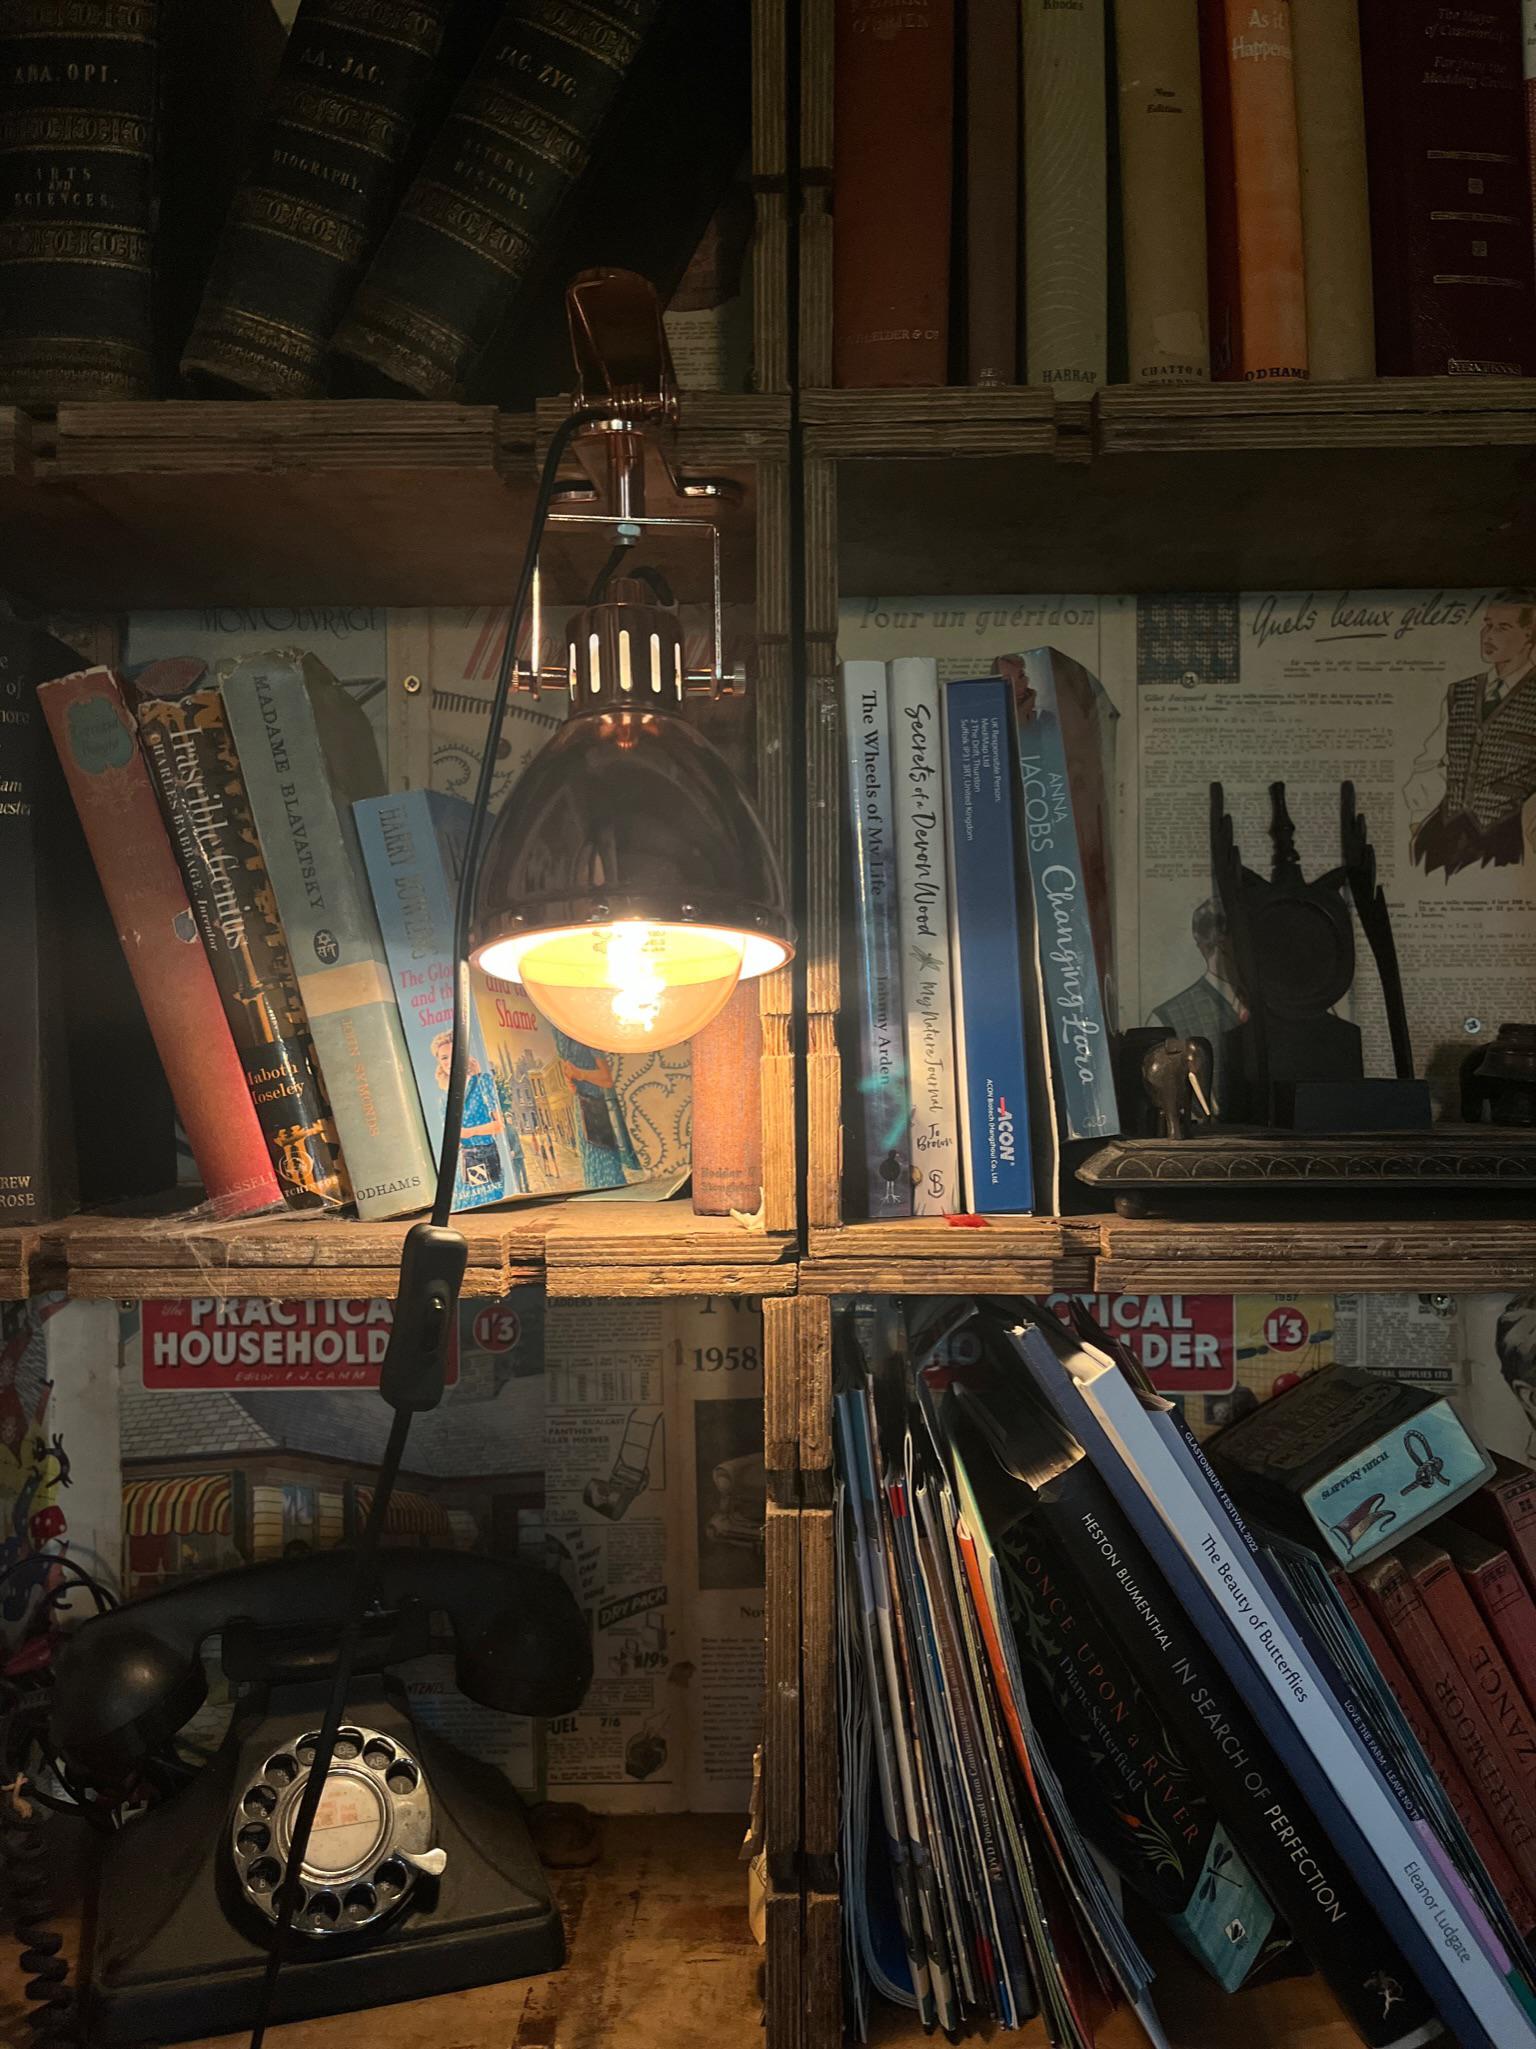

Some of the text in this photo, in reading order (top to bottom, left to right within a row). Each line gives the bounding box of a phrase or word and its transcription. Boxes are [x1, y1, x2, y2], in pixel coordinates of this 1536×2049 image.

[1249, 9, 1286, 29] As it
[1042, 368, 1098, 384] HARRAP
[934, 609, 967, 627] un
[975, 596, 1096, 636] guéridon
[904, 703, 936, 783] Secrets
[151, 733, 179, 811] CHARLES
[253, 675, 325, 913] MADAME BLAVATSKY
[861, 690, 886, 897] The Wheels of My Life
[1047, 772, 1068, 823] ANNA
[170, 727, 252, 951] Irascible Genius
[911, 812, 937, 879] Devon
[913, 882, 941, 937] Wood
[400, 969, 425, 990] The
[411, 986, 437, 1008] and
[1041, 864, 1100, 1085] Changing Lara
[495, 999, 538, 1031] Shame
[878, 1036, 893, 1085] Arden
[986, 1079, 994, 1097] ACON
[356, 1176, 421, 1201] ODHAMS
[191, 1299, 396, 1327] PRACTICA
[693, 1346, 758, 1372] 1958
[1361, 1451, 1391, 1477] HITCH
[1184, 1430, 1260, 1554] GLASTONBURY FESTIVAL 2022
[601, 1589, 666, 1626] DRY PACK
[1023, 1555, 1059, 1635] ONCE
[1076, 1642, 1130, 1724] UPON
[1141, 1750, 1201, 1844] RIVER
[1080, 1511, 1348, 1923] HESTON BLUMENTHAL IN SEARCH OF PERFECTION
[1088, 1704, 1144, 1793] Setterfield
[1201, 1534, 1471, 1965] The Beauty of Butterflies Eleanor Ludgate
[1344, 1699, 1361, 1725] LOVE
[1358, 1723, 1373, 1743] THE
[1385, 1769, 1407, 1799] LEAVE
[1434, 1673, 1536, 1849] DARTMOOR
